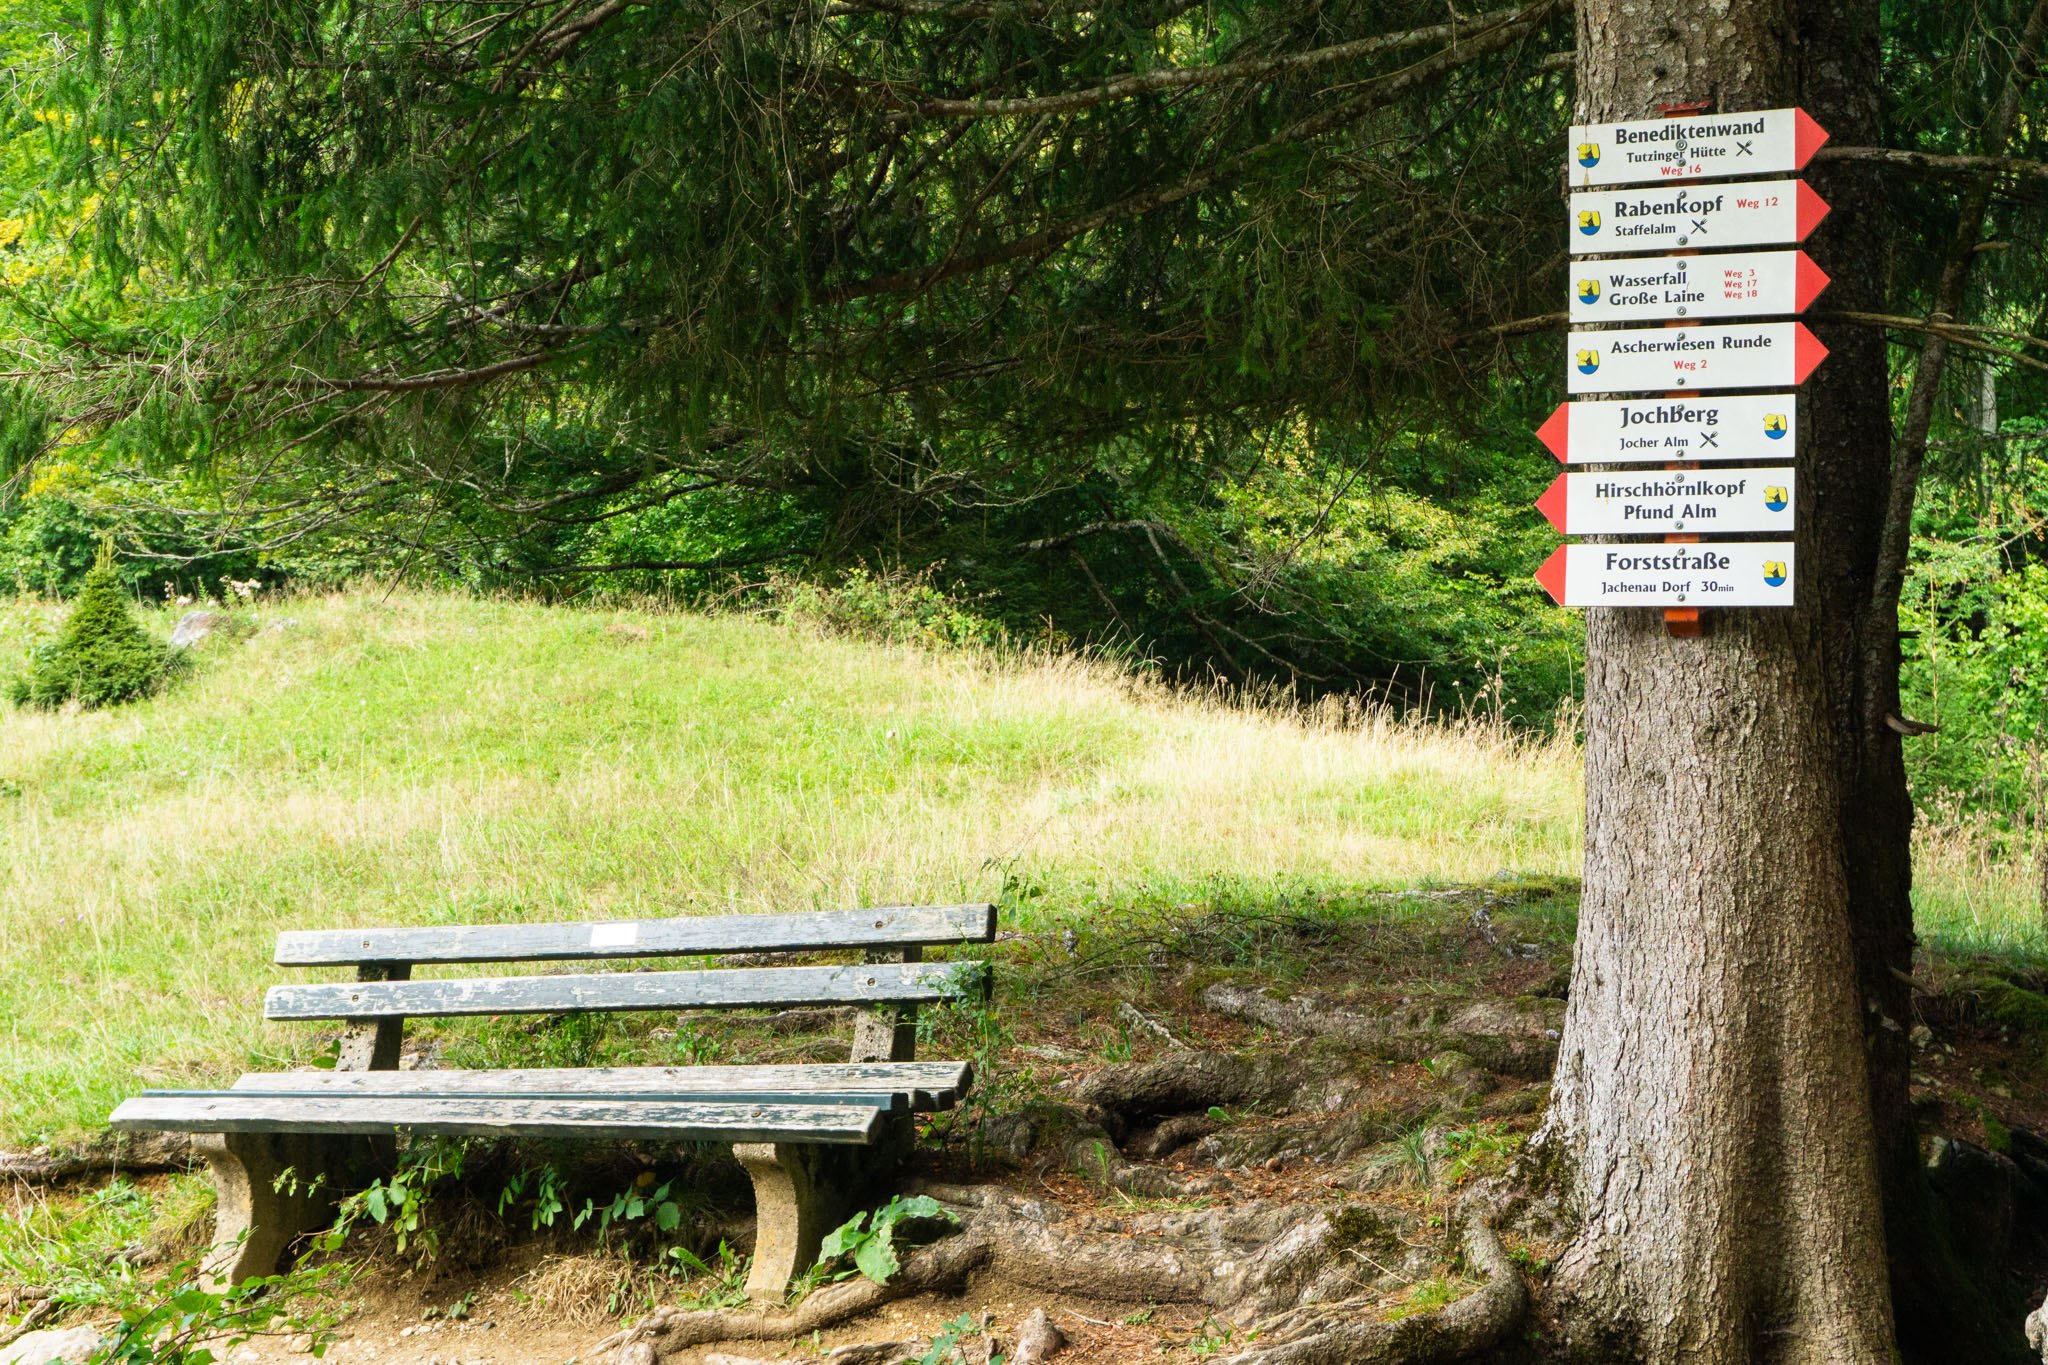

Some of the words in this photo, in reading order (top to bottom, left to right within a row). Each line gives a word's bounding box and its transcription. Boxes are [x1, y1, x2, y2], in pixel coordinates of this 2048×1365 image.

[1615, 117, 1765, 145] Benediktenwand
[1626, 149, 1685, 163] Tutzinger
[1690, 146, 1726, 159] Hütte
[1660, 166, 1683, 177] Weg
[1688, 165, 1702, 174] 16
[1614, 195, 1724, 218] Rabenkopf
[1736, 198, 1759, 210] Weg
[1764, 197, 1778, 207] 12
[1615, 223, 1676, 237] Staffelalm
[1609, 271, 1687, 288] Wasserfall
[1723, 269, 1743, 279] Weg
[1748, 268, 1755, 277] 3
[1723, 280, 1743, 290] Weg
[1745, 279, 1758, 288] 17
[1609, 291, 1658, 306] Große
[1664, 290, 1705, 303] Laine
[1723, 290, 1743, 300] Weg
[1745, 289, 1758, 298] 18
[1610, 338, 1715, 354] Ascherwiesen
[1722, 334, 1772, 350] Runde
[1673, 360, 1696, 371] Weg
[1700, 359, 1707, 369] 2
[1620, 406, 1719, 428] Jochberg
[1619, 437, 1659, 451] Jocher
[1663, 436, 1689, 447] Alm
[1595, 479, 1746, 498] Hirschhörnlkopf
[1623, 504, 1674, 520] Pfund
[1681, 504, 1717, 518] Alm
[1605, 551, 1730, 570] Forststraße
[1601, 580, 1657, 595] Jachenau
[1662, 580, 1691, 593] Dorf
